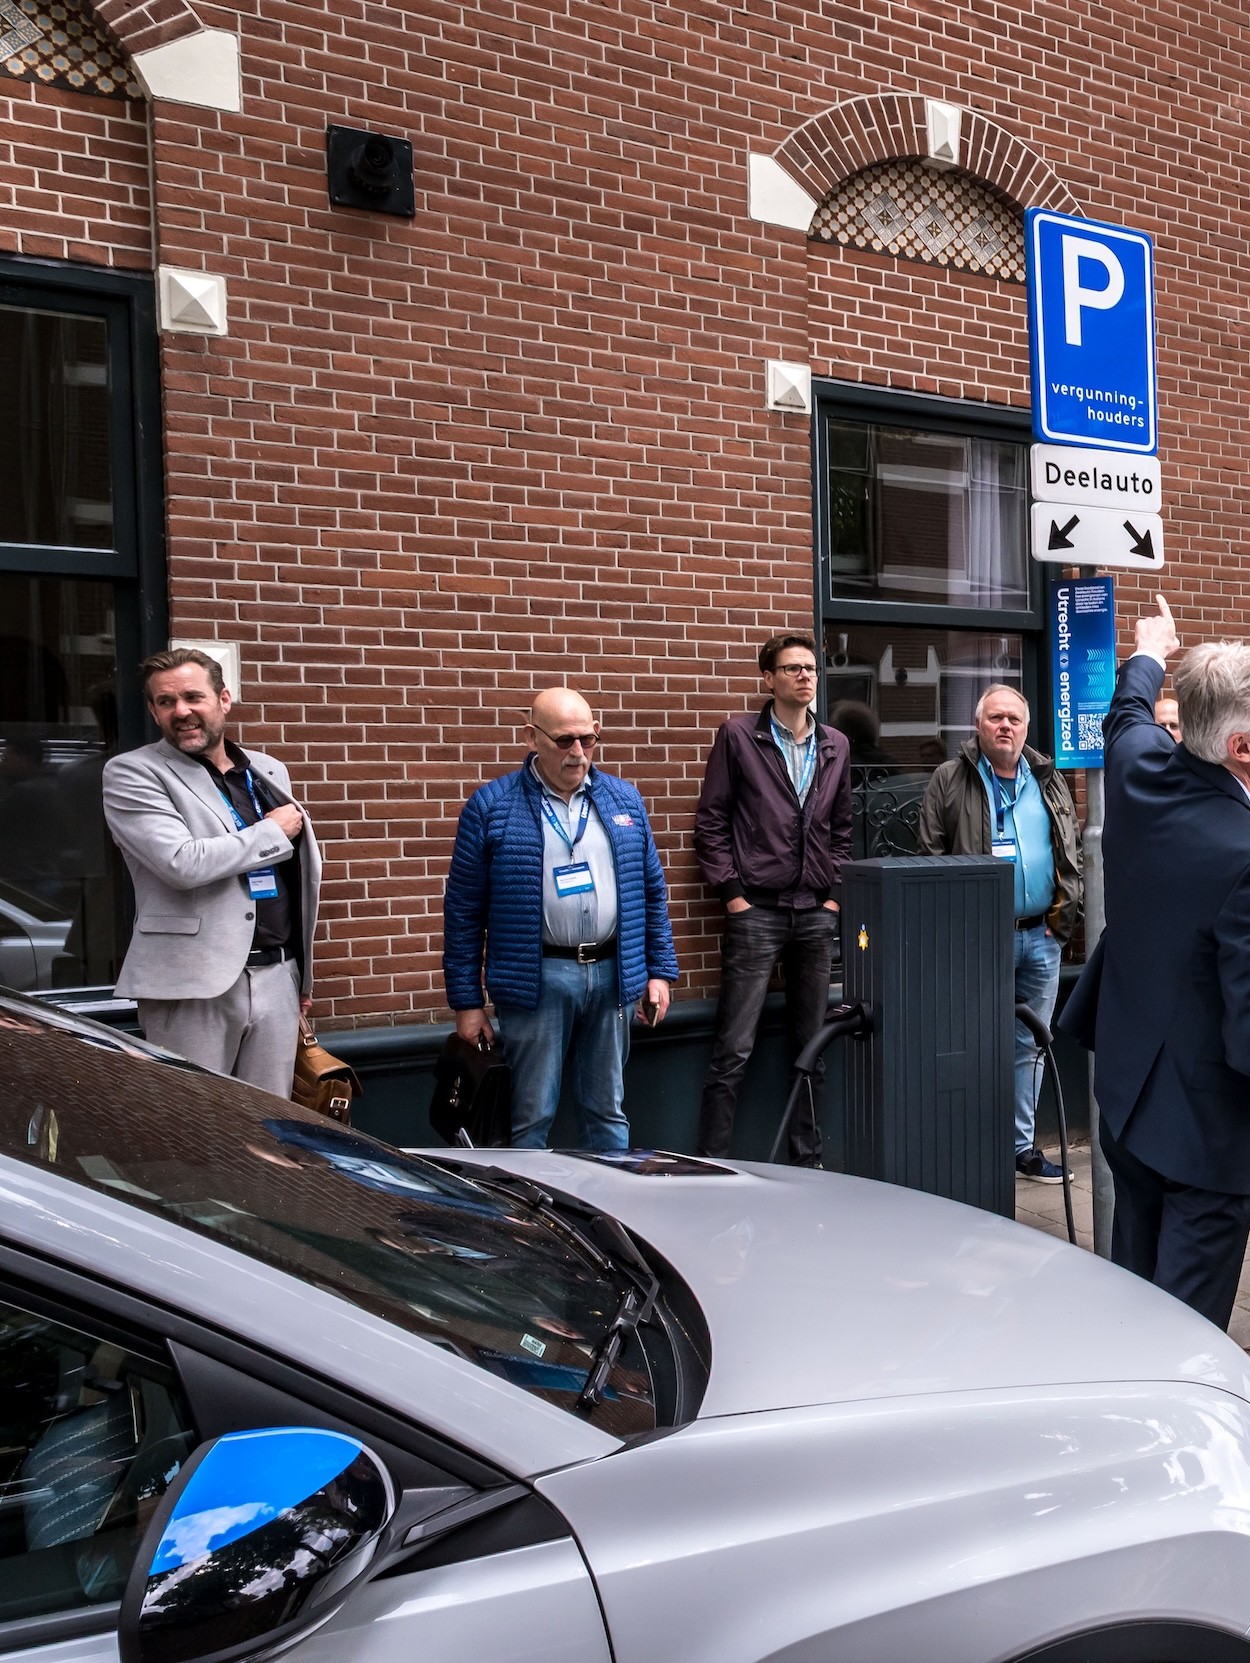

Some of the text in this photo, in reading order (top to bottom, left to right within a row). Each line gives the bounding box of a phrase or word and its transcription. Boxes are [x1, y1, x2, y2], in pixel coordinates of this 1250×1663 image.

[1062, 234, 1125, 346] P
[1051, 382, 1144, 411] vergunning-
[1087, 405, 1145, 427] houders
[1045, 462, 1153, 494] Deelauto
[1057, 588, 1075, 751] Utrecht energized
